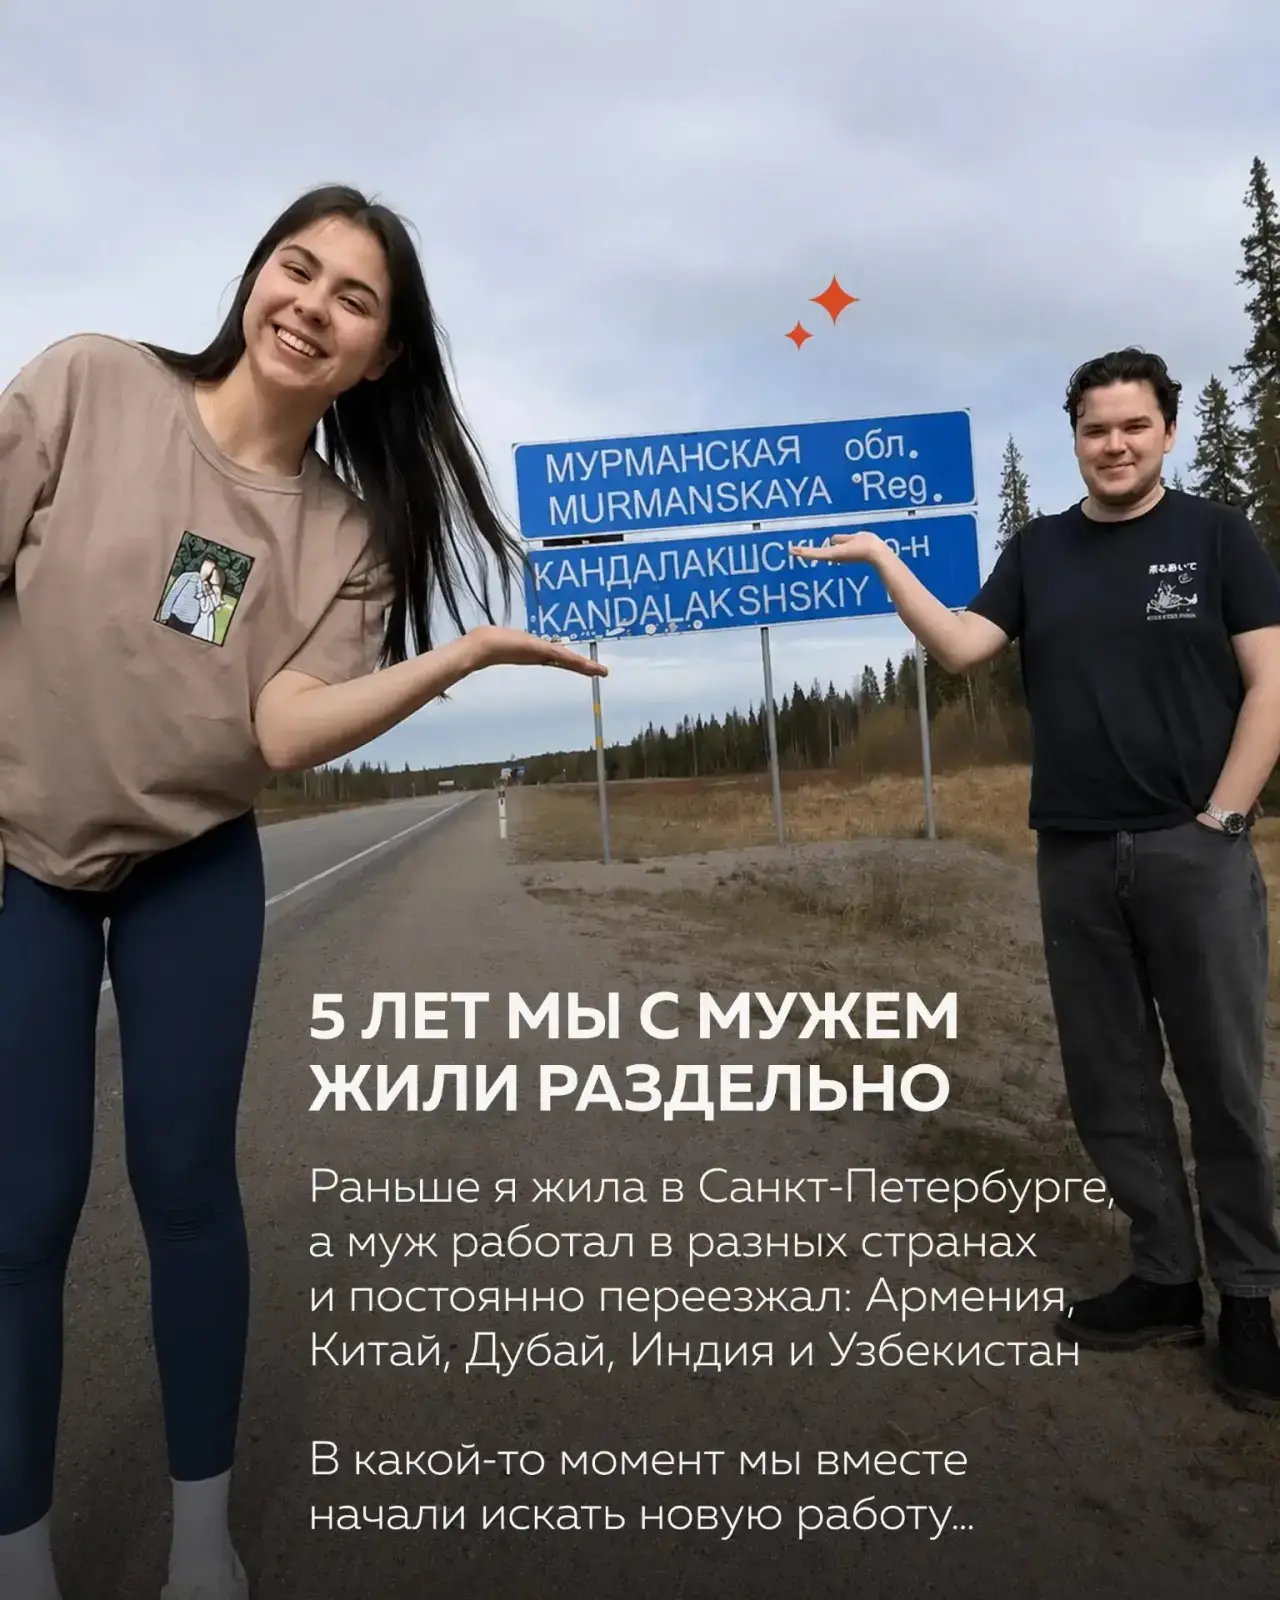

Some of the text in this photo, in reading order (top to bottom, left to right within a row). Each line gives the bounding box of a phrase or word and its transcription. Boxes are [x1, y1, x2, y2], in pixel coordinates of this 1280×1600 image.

[545, 427, 920, 483] МУРМАНСКАЯ обл.
[548, 469, 943, 527] MURMANSKAYA Reg.
